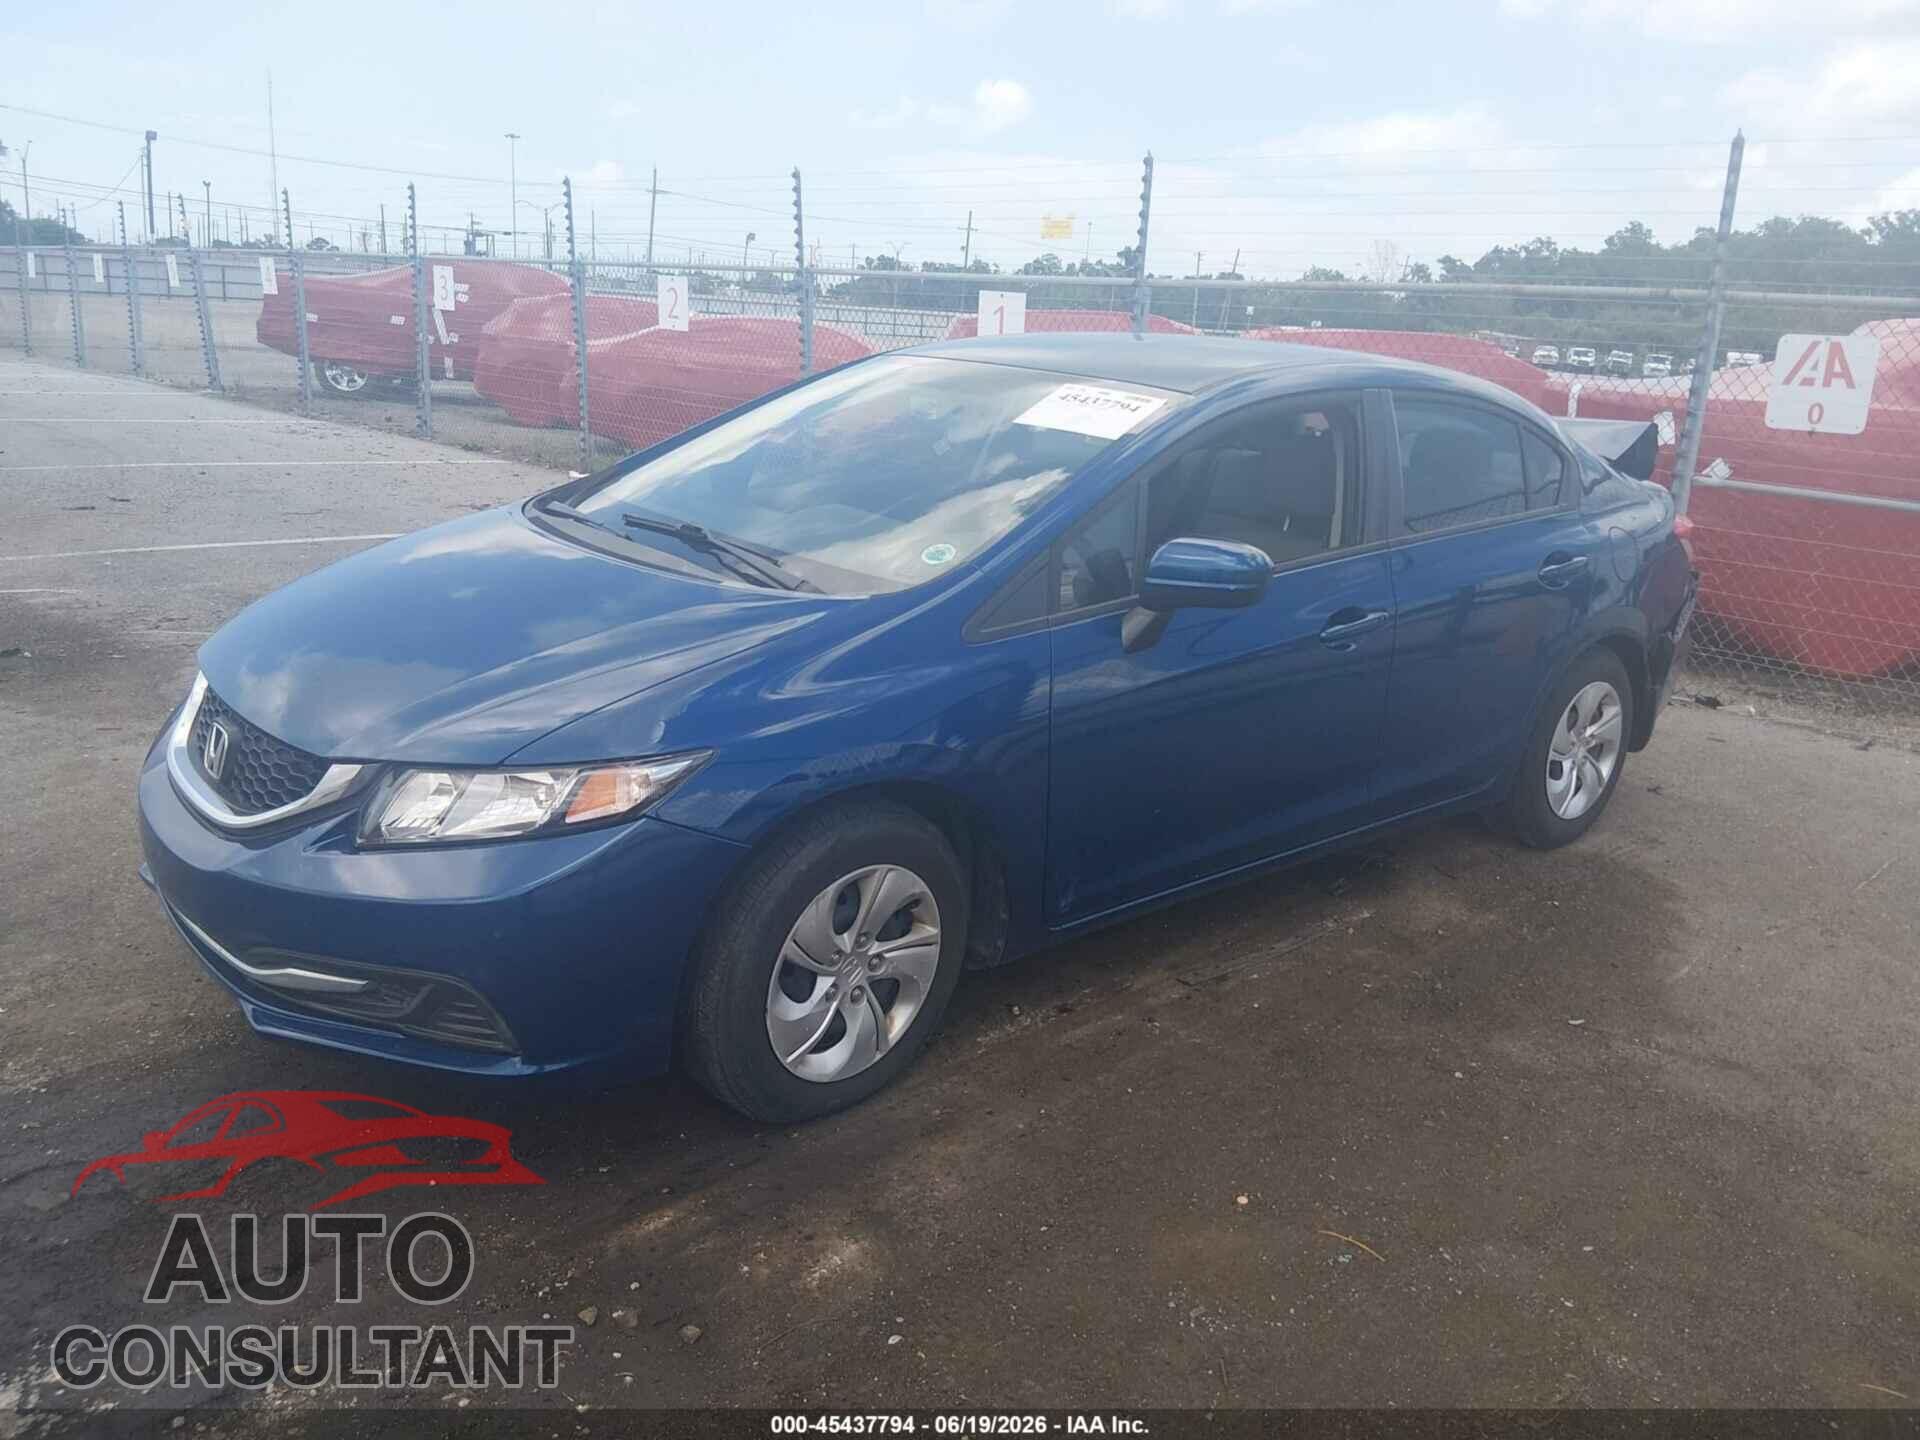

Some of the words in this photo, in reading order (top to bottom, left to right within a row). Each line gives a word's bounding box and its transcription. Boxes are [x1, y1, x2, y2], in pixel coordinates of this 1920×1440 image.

[440, 274, 448, 301] 3
[667, 287, 679, 319] 2
[993, 304, 1004, 336] 1
